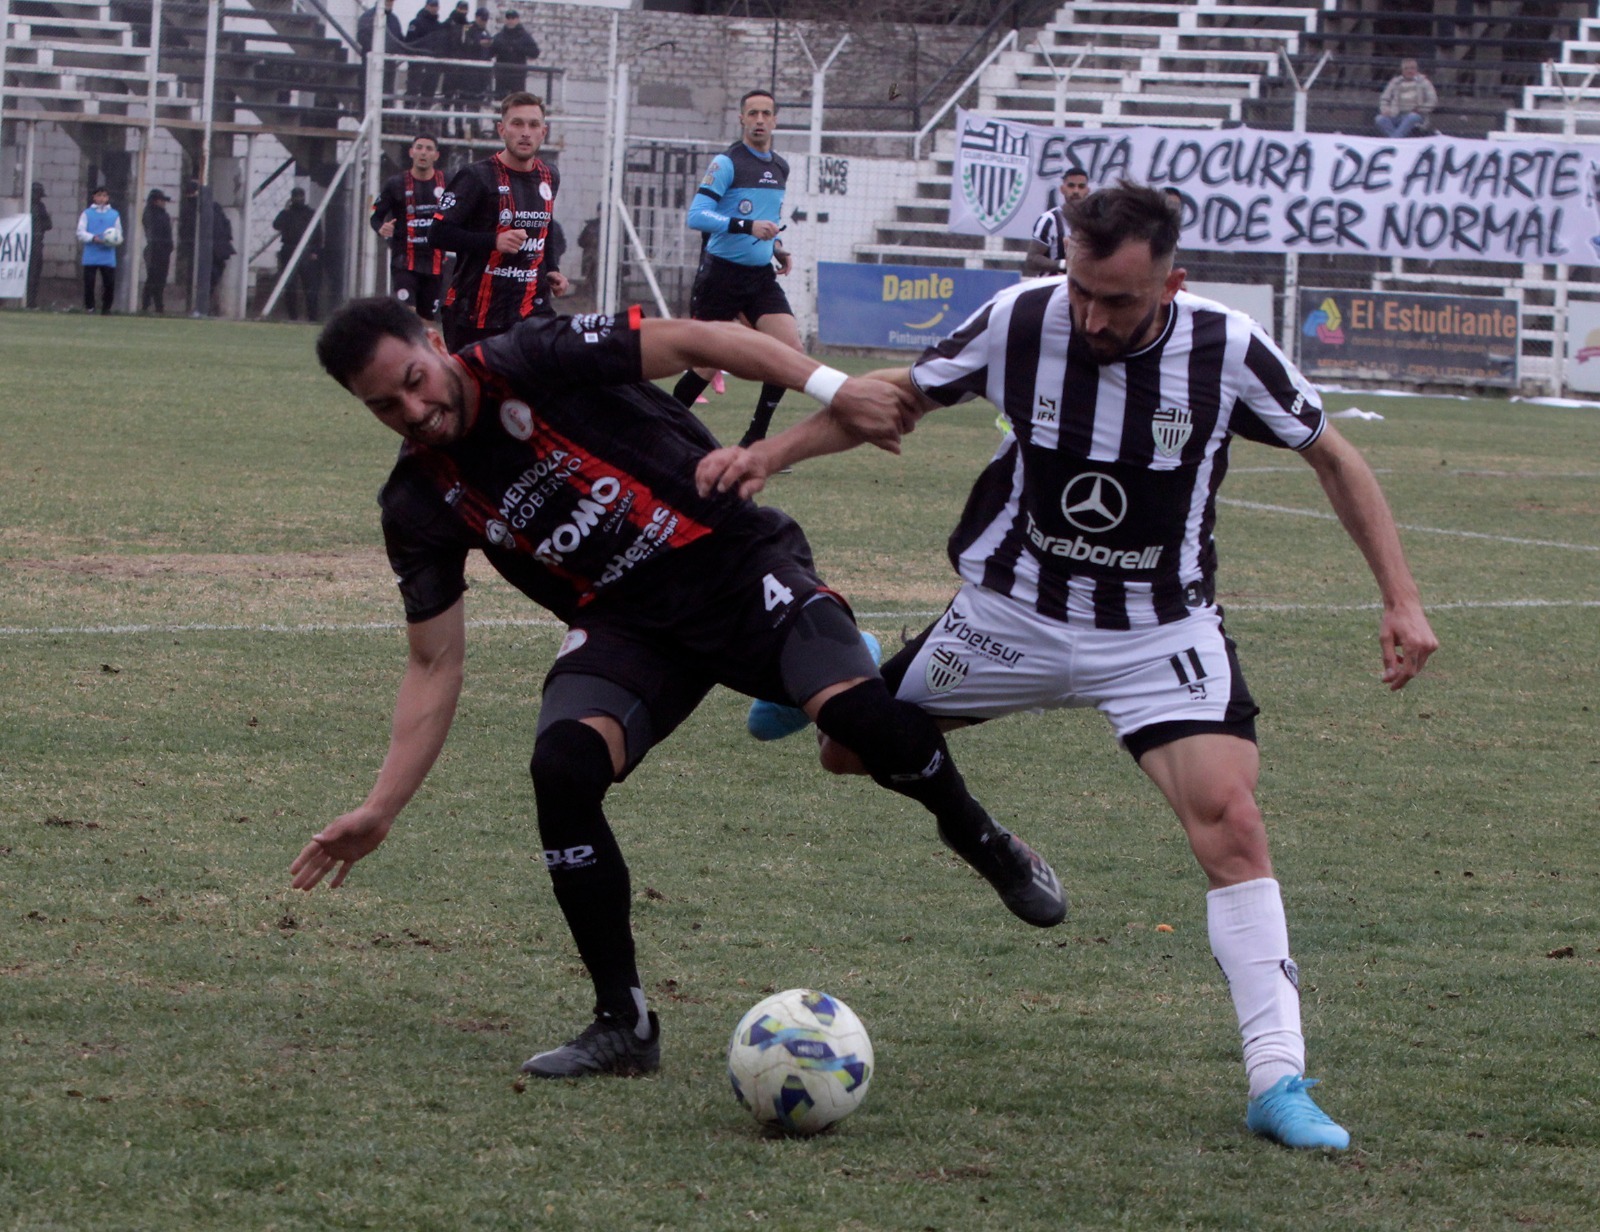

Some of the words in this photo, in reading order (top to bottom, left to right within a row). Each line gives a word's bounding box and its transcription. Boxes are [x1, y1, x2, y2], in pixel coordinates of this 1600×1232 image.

[1037, 135, 1135, 181] ESTA
[1146, 136, 1314, 190] LOCURA
[1330, 143, 1397, 191] DE
[1402, 144, 1582, 199] AMARTE
[0, 232, 28, 262] AN
[1284, 196, 1370, 250] SER
[1379, 202, 1569, 258] NORMAL
[882, 273, 954, 302] Dante
[1351, 300, 1374, 329] El
[1384, 301, 1517, 338] Estudiante
[1037, 411, 1056, 422] IFK
[499, 449, 569, 519] MENDOZA
[1027, 510, 1164, 570] Taraborelli
[762, 573, 795, 611] 4
[956, 623, 1025, 664] betsur
[1169, 646, 1208, 686] 11
